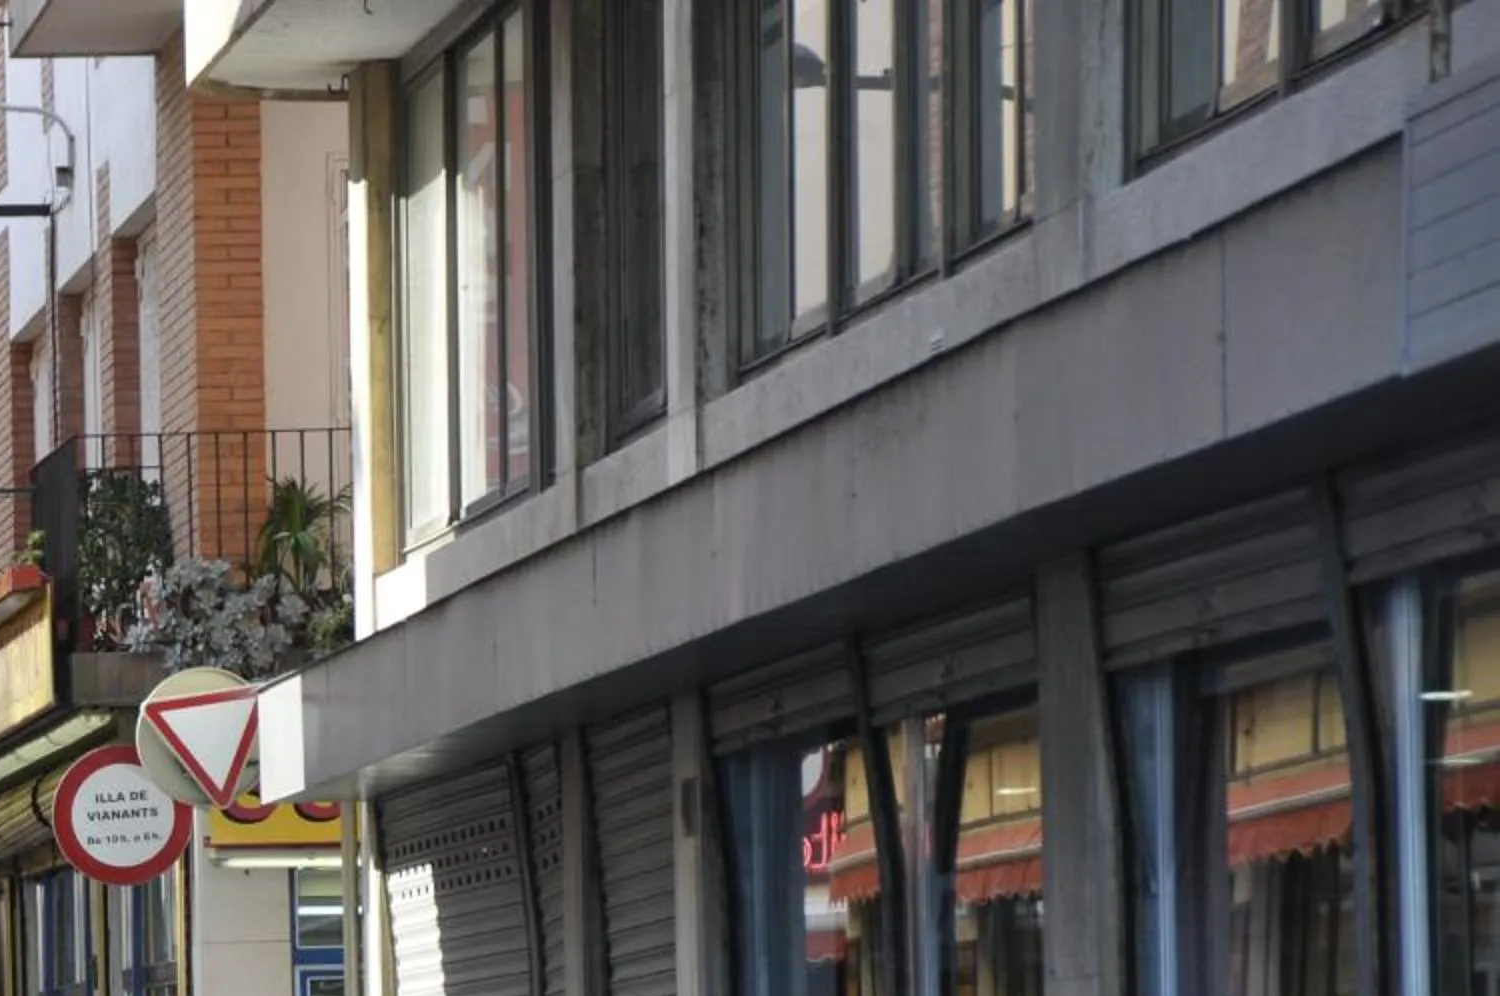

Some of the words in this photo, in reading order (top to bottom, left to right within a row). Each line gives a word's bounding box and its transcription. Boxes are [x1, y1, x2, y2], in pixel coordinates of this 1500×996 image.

[95, 791, 125, 803] ILLA
[129, 790, 148, 801] DE
[87, 807, 159, 821] VIANANTS
